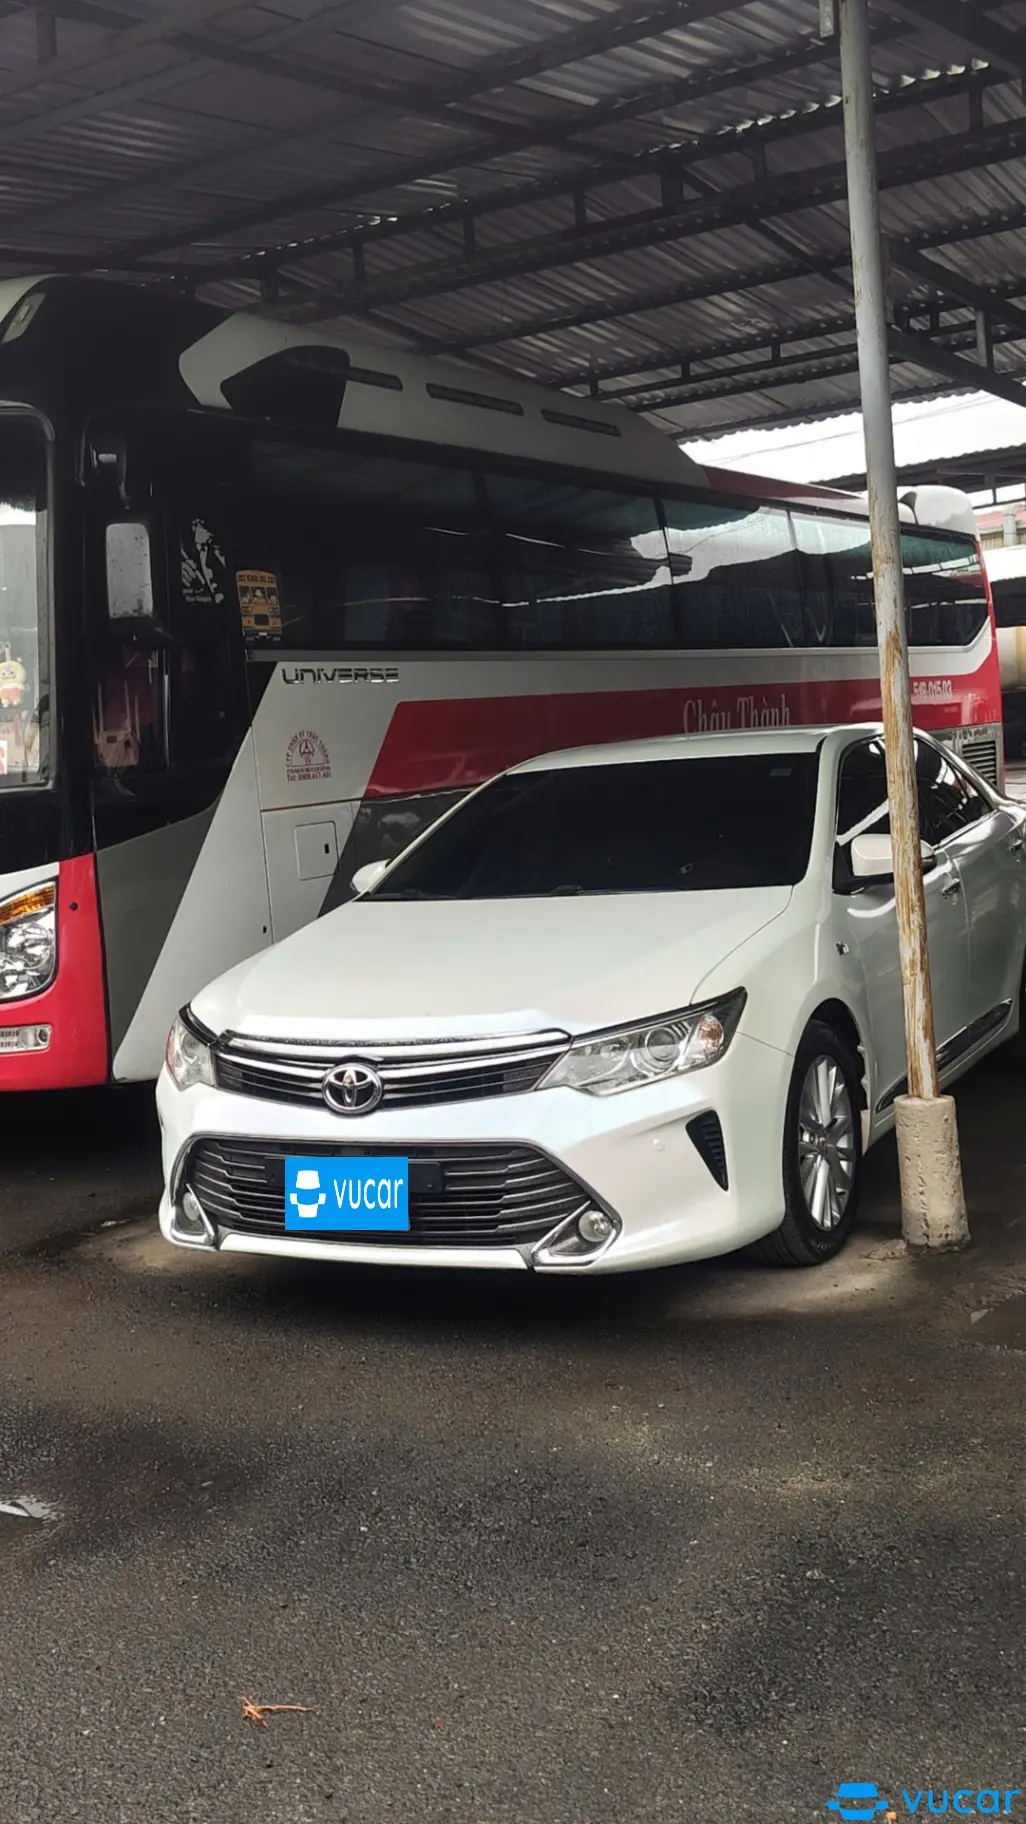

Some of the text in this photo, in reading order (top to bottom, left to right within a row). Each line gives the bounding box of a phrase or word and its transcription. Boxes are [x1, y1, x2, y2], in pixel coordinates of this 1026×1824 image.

[282, 668, 399, 684] UNIVERSE
[683, 693, 790, 734] Châu Thành
